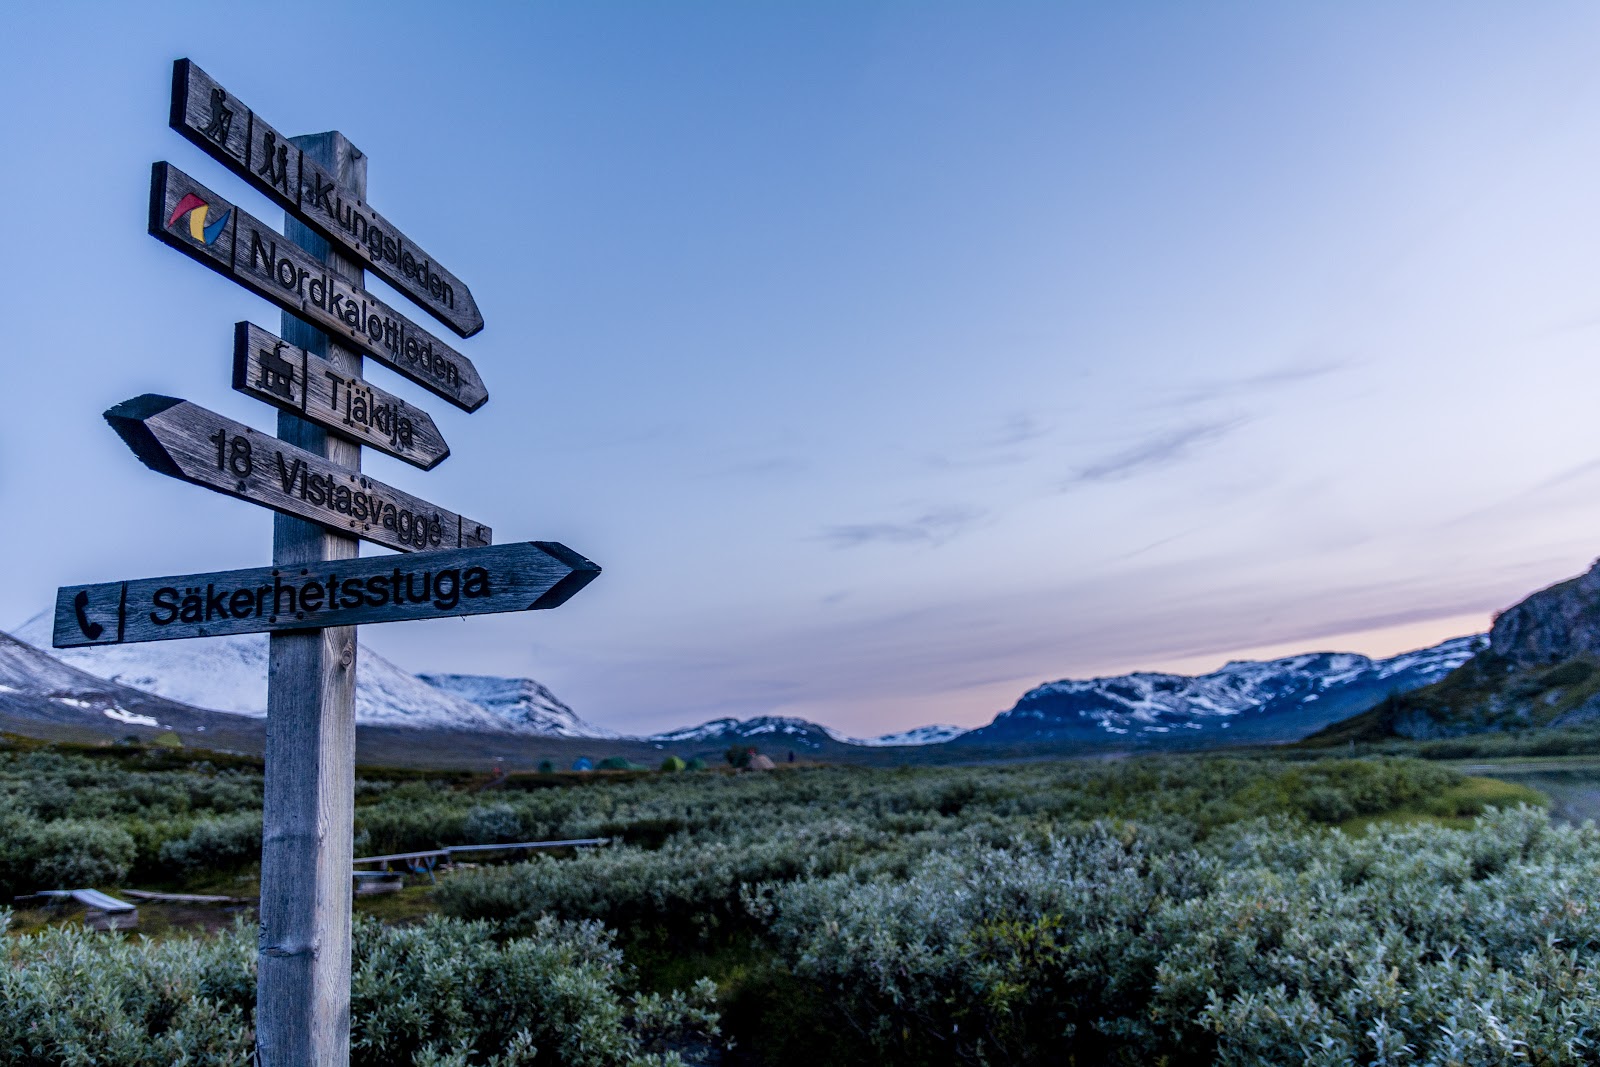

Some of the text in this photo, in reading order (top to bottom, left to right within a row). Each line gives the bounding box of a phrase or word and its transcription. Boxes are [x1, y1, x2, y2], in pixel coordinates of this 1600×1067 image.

[313, 173, 454, 310] Kungsleden
[250, 229, 459, 389] Nordkalottleden
[325, 370, 413, 446] Tjäktja
[210, 428, 252, 478] 18
[149, 566, 492, 626] Säkerhetsstuga
